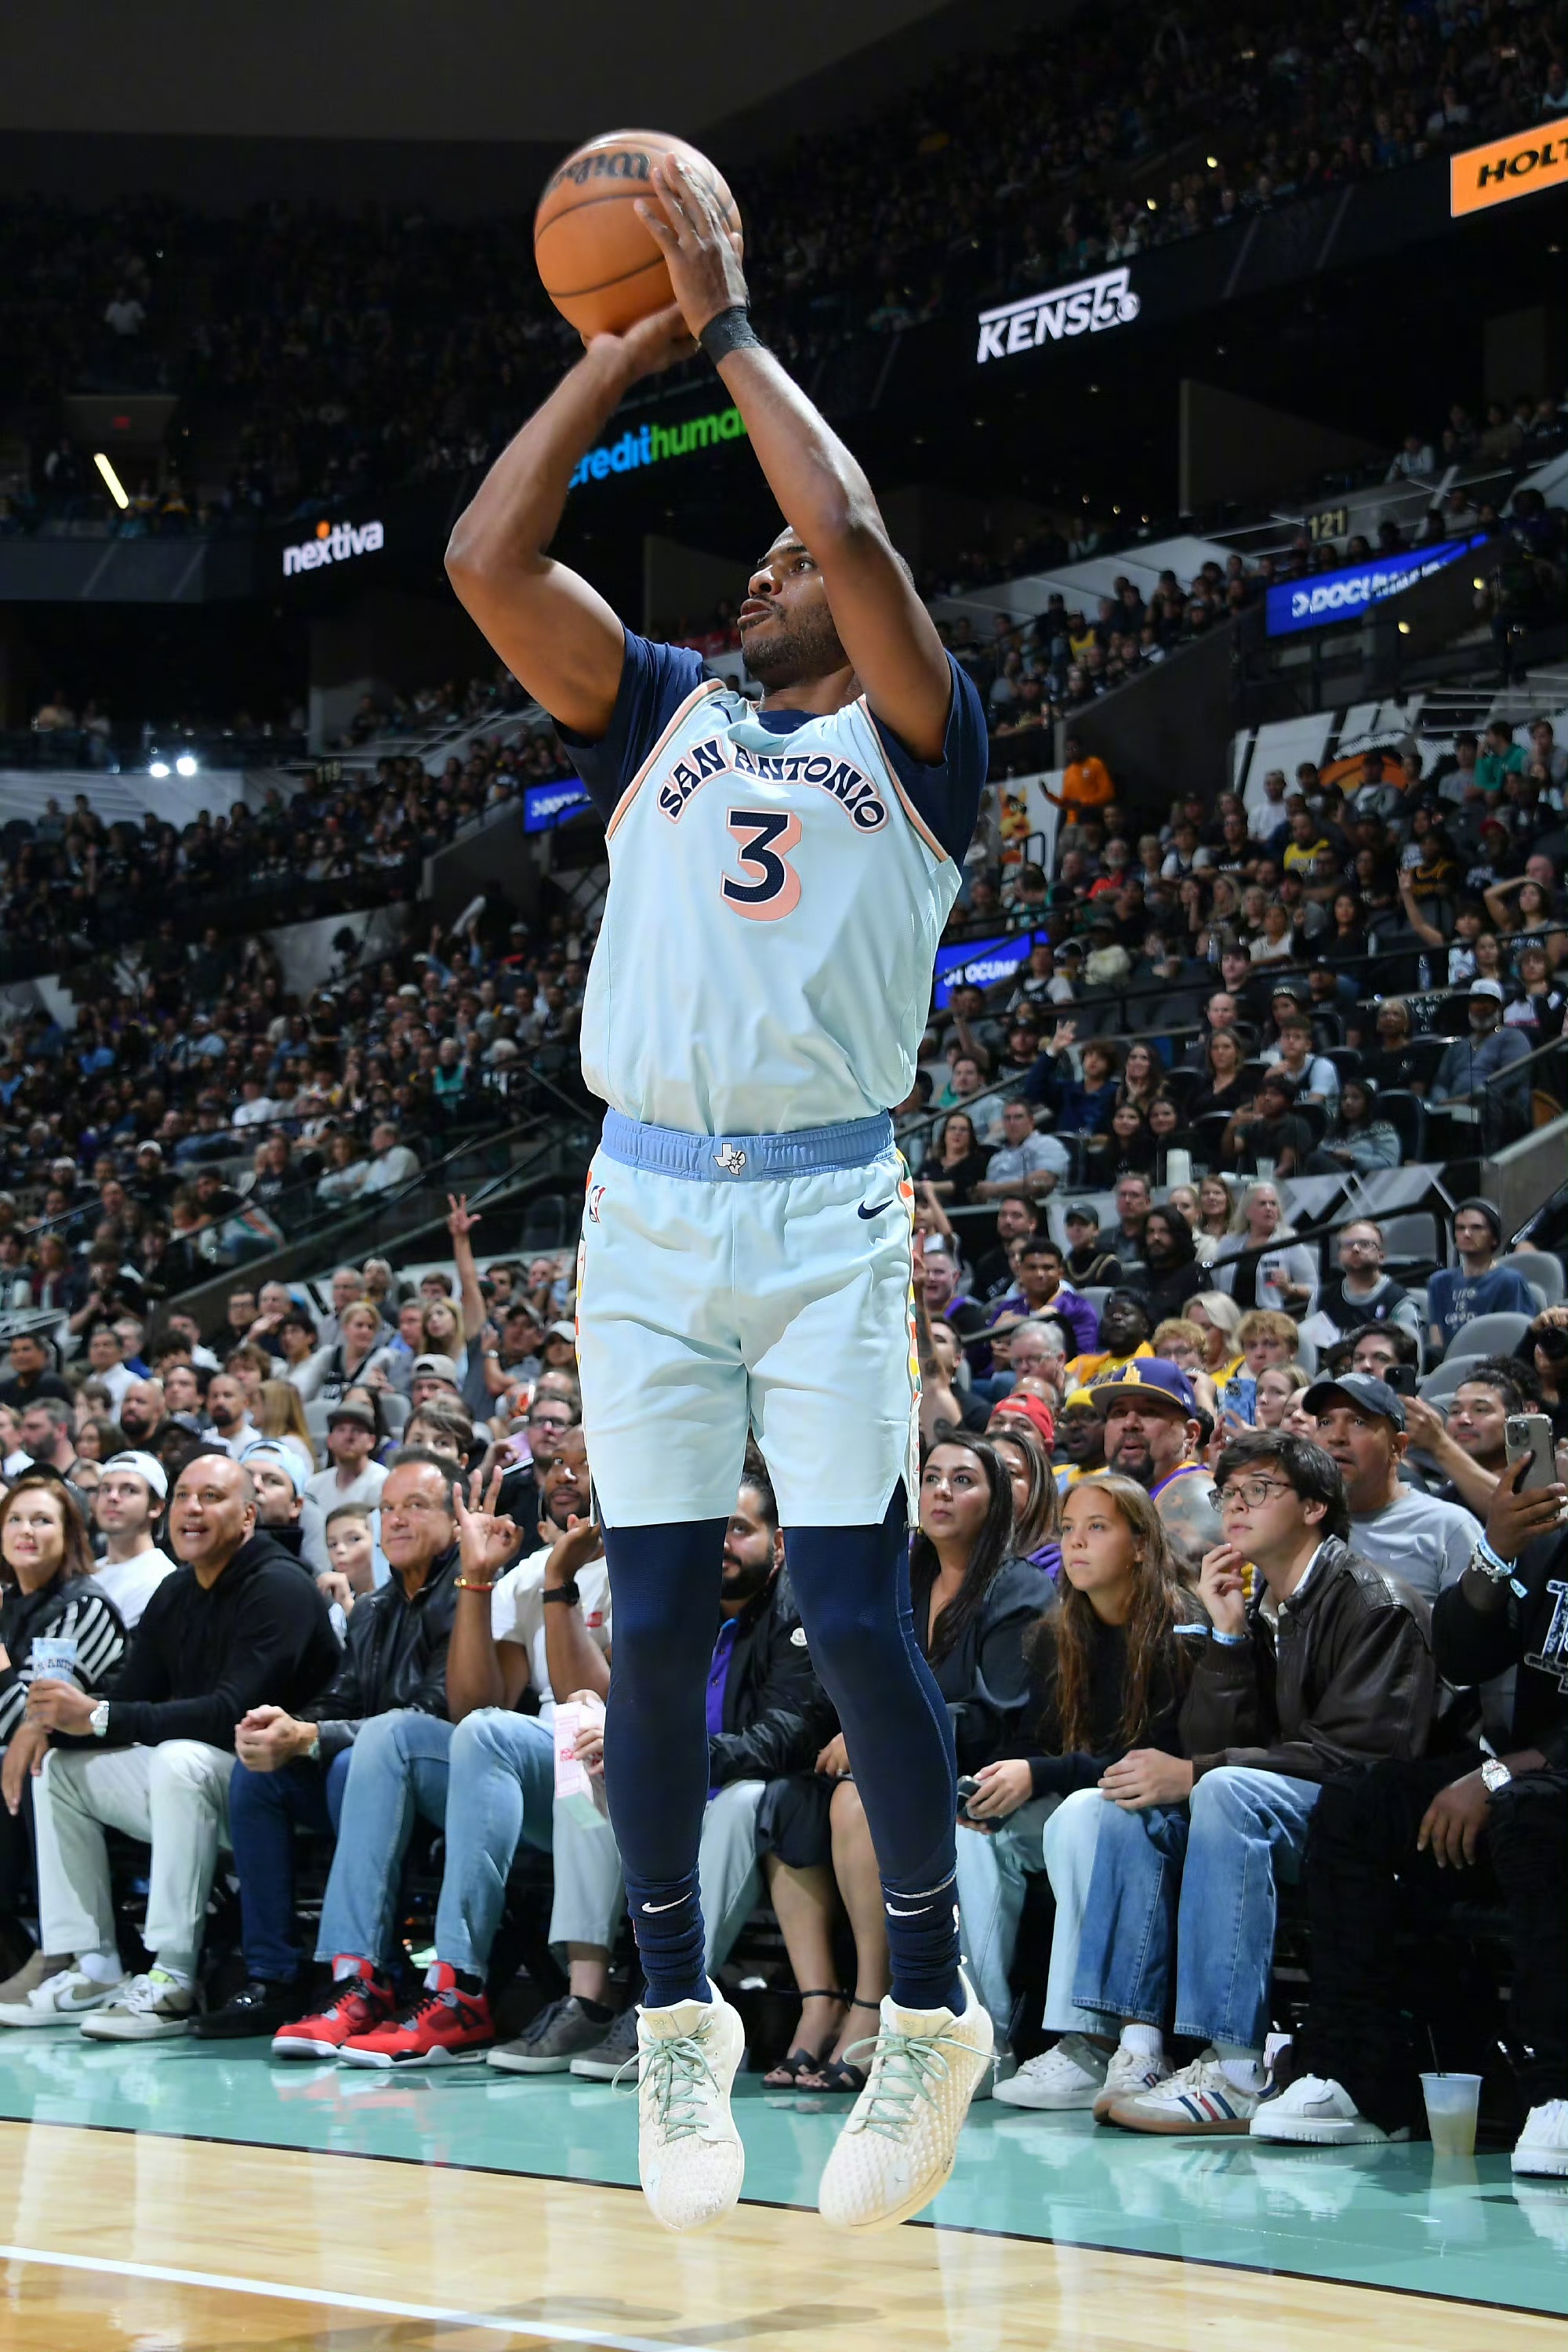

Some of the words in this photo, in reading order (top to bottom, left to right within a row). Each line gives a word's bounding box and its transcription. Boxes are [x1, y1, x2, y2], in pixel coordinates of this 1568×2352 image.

[568, 406, 747, 489] redithuma
[283, 521, 384, 576] nextiva
[1308, 510, 1345, 540] 121
[659, 739, 728, 820] SAN
[733, 741, 887, 830] ANTONIO
[722, 808, 790, 904] 3
